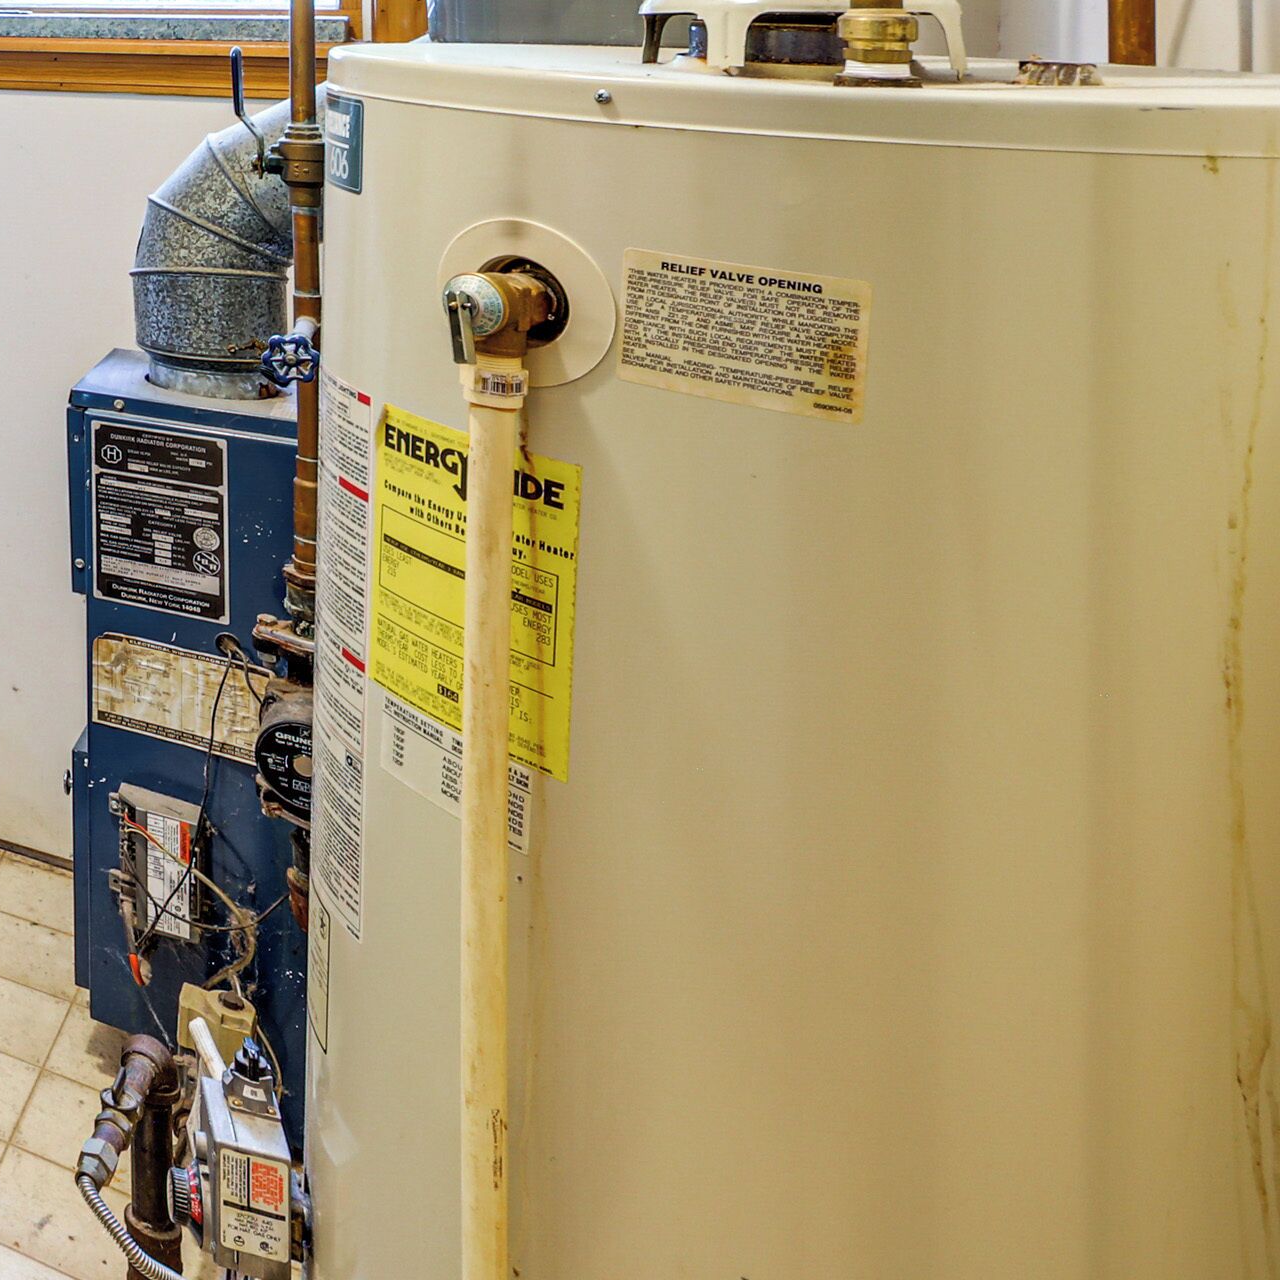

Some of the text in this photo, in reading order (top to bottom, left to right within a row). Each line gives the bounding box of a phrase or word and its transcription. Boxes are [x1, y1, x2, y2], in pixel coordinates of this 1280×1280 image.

[647, 271, 669, 279] WATER
[671, 276, 697, 284] HEATER
[709, 282, 744, 292] PROVIDED
[776, 292, 825, 303] COMBINATION
[661, 261, 823, 294] RELIEF VALVE OPENING
[688, 284, 710, 292] RELIEF
[787, 300, 828, 310] OPERATION
[700, 292, 723, 300] RELIEF
[823, 311, 860, 321] REMOVED
[110, 433, 207, 454] DUNKIRK RADIATOR CORPORATION
[514, 469, 565, 510] IDE
[384, 479, 575, 560] Compare the Energy Us ater Heater
[409, 506, 425, 518] with
[427, 513, 452, 531] Others
[512, 547, 527, 560] uy.
[512, 566, 530, 580] ODEL
[534, 574, 554, 588] USES
[523, 617, 552, 636] ENERGY
[532, 610, 552, 625] MOST
[129, 639, 171, 654] ELECTRICAL
[399, 630, 409, 644] GAS
[412, 637, 428, 653] WATER
[431, 648, 458, 670] HEATERS
[399, 649, 454, 686] ESTIMATED YEARLY
[414, 648, 428, 664] COST
[431, 658, 446, 673] LESS
[450, 666, 458, 678] TO
[385, 696, 444, 737] TEMPERATURE SETTING
[275, 731, 313, 745] GRUND
[442, 764, 462, 778] ABOU
[443, 756, 463, 772] ABOU
[441, 781, 461, 795] ABOU
